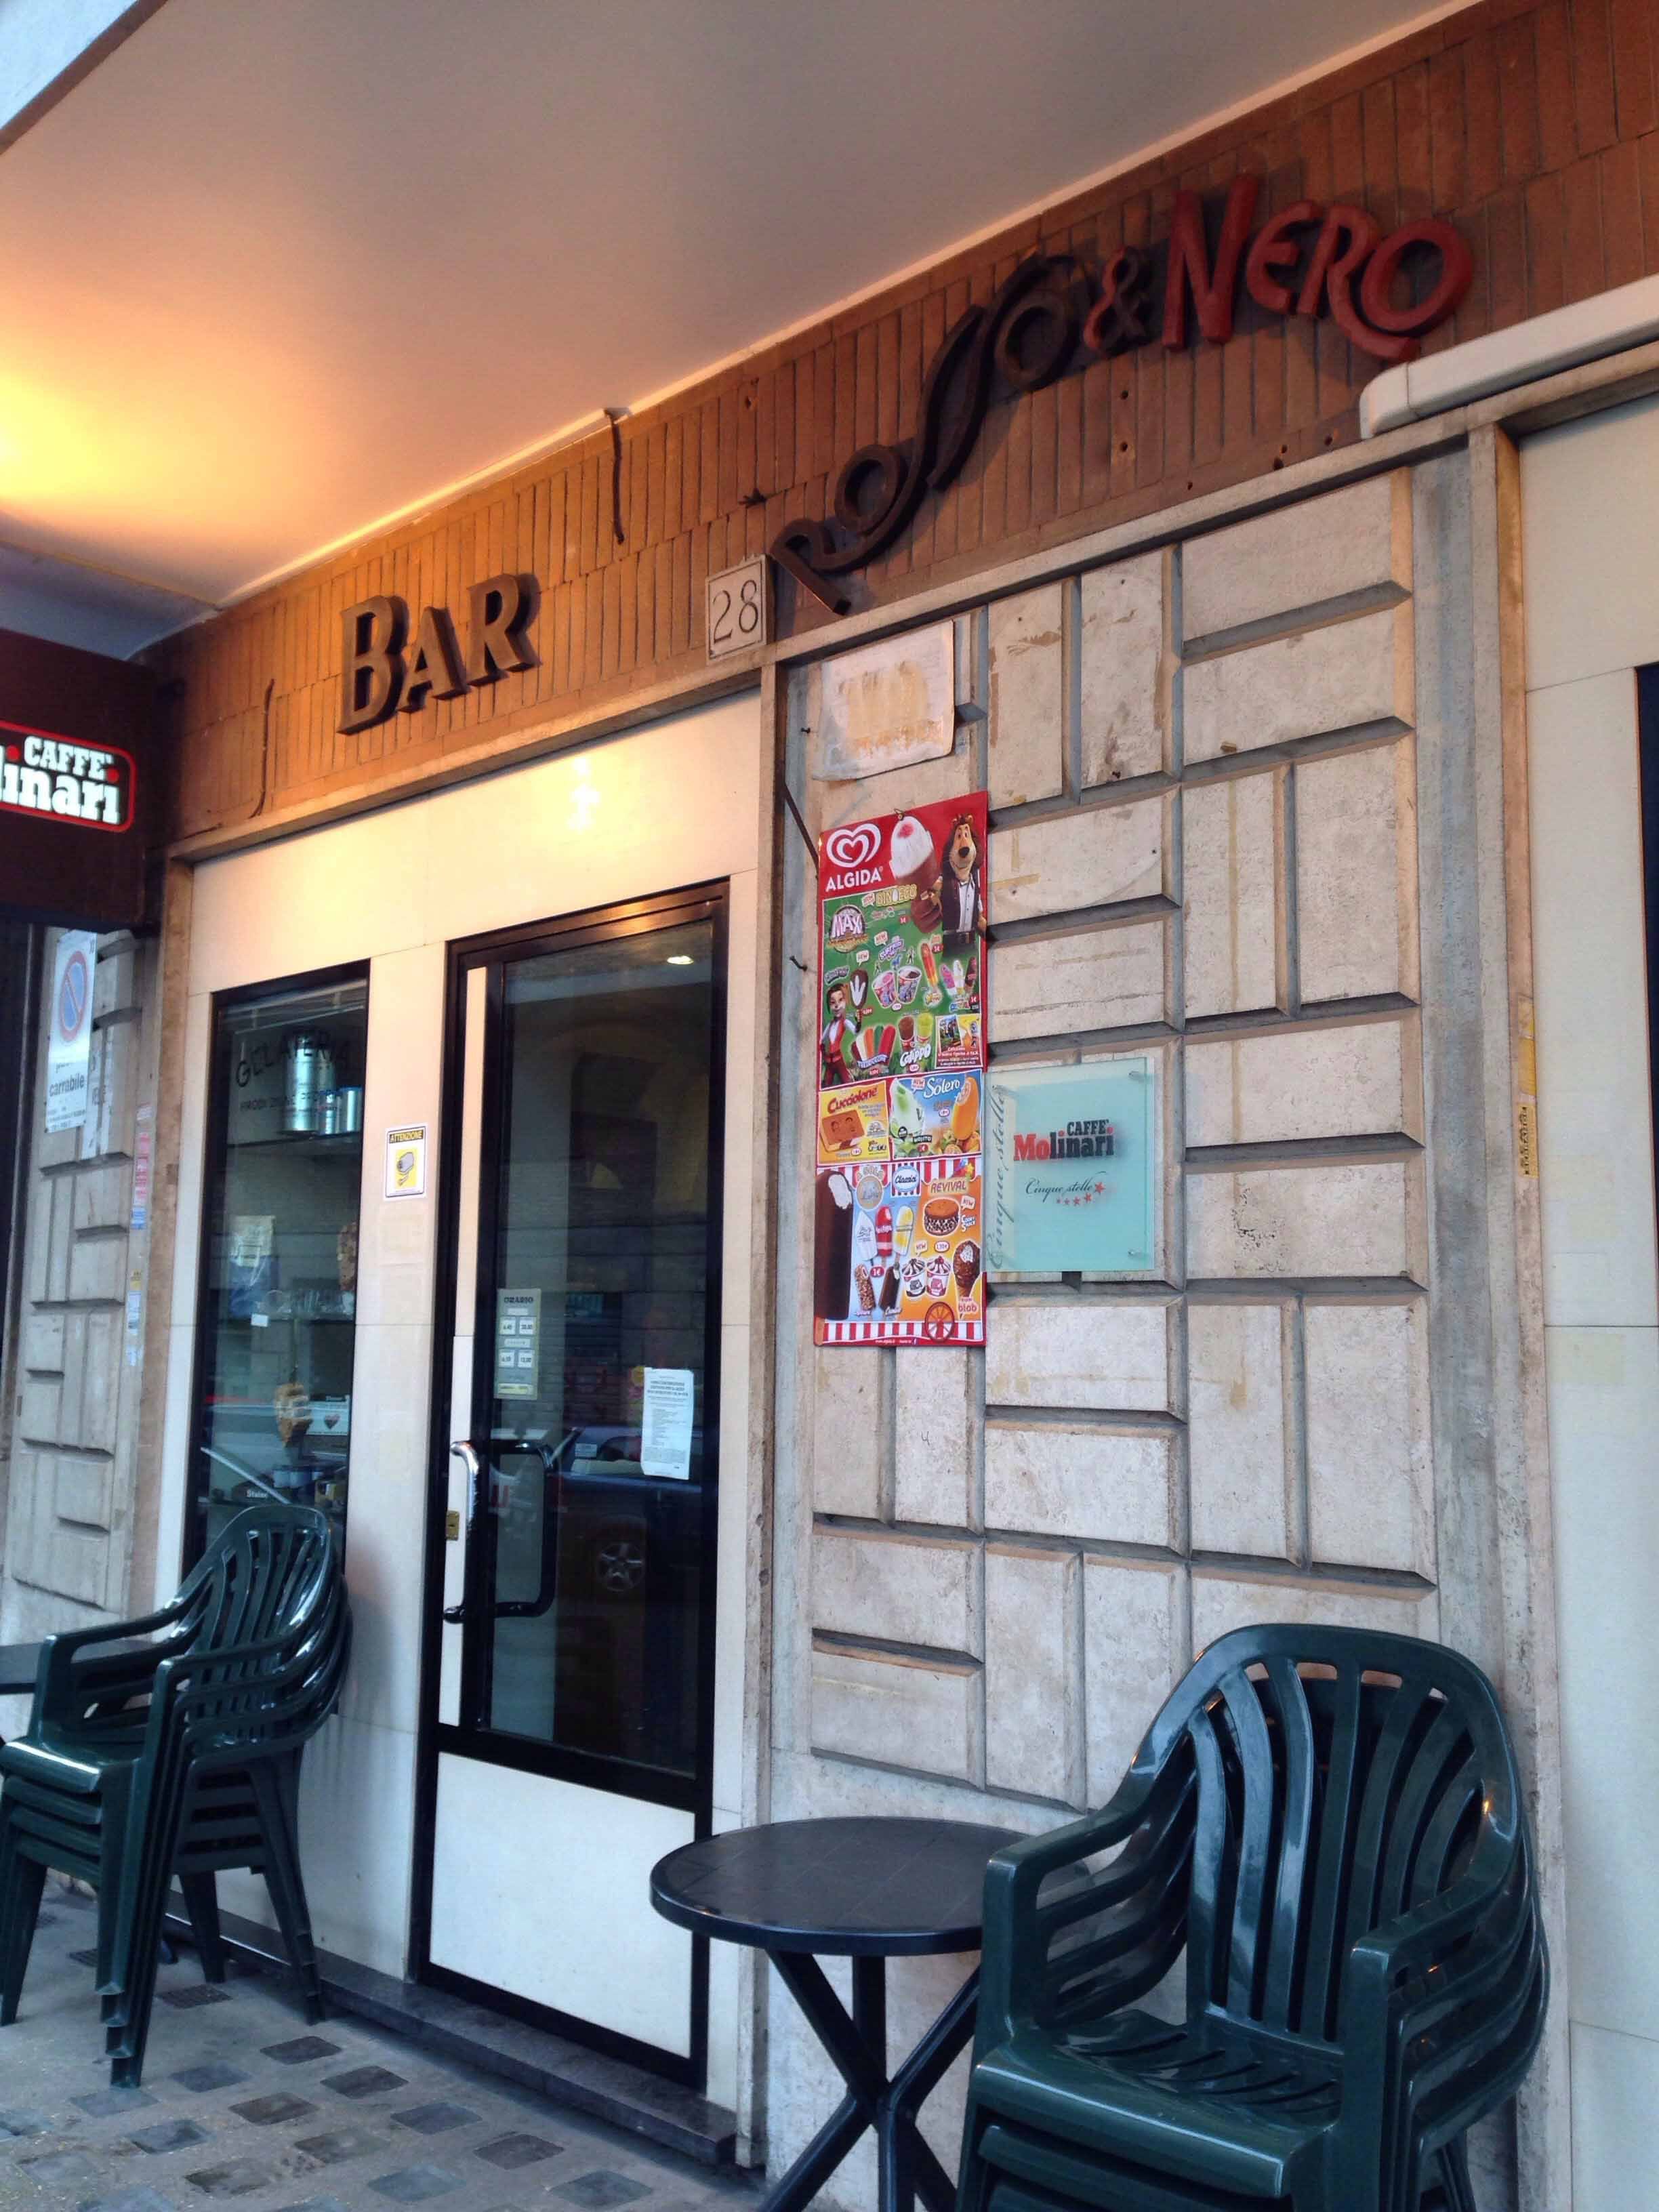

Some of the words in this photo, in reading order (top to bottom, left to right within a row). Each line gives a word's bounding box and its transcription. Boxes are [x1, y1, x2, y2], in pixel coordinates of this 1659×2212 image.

[1084, 244, 1150, 354] &
[712, 579, 758, 643] 28
[337, 573, 542, 735] BAR
[0, 744, 120, 825] inari
[825, 867, 882, 892] ALGIDA
[49, 1073, 85, 1097] carrabile
[924, 1078, 960, 1098] Solero
[390, 1130, 423, 1143] ATTENZIONE
[1013, 1126, 1114, 1162] Molinari
[930, 1181, 966, 1193] REVIVAL
[1025, 1177, 1064, 1203] Cinque
[958, 1304, 977, 1313] blob
